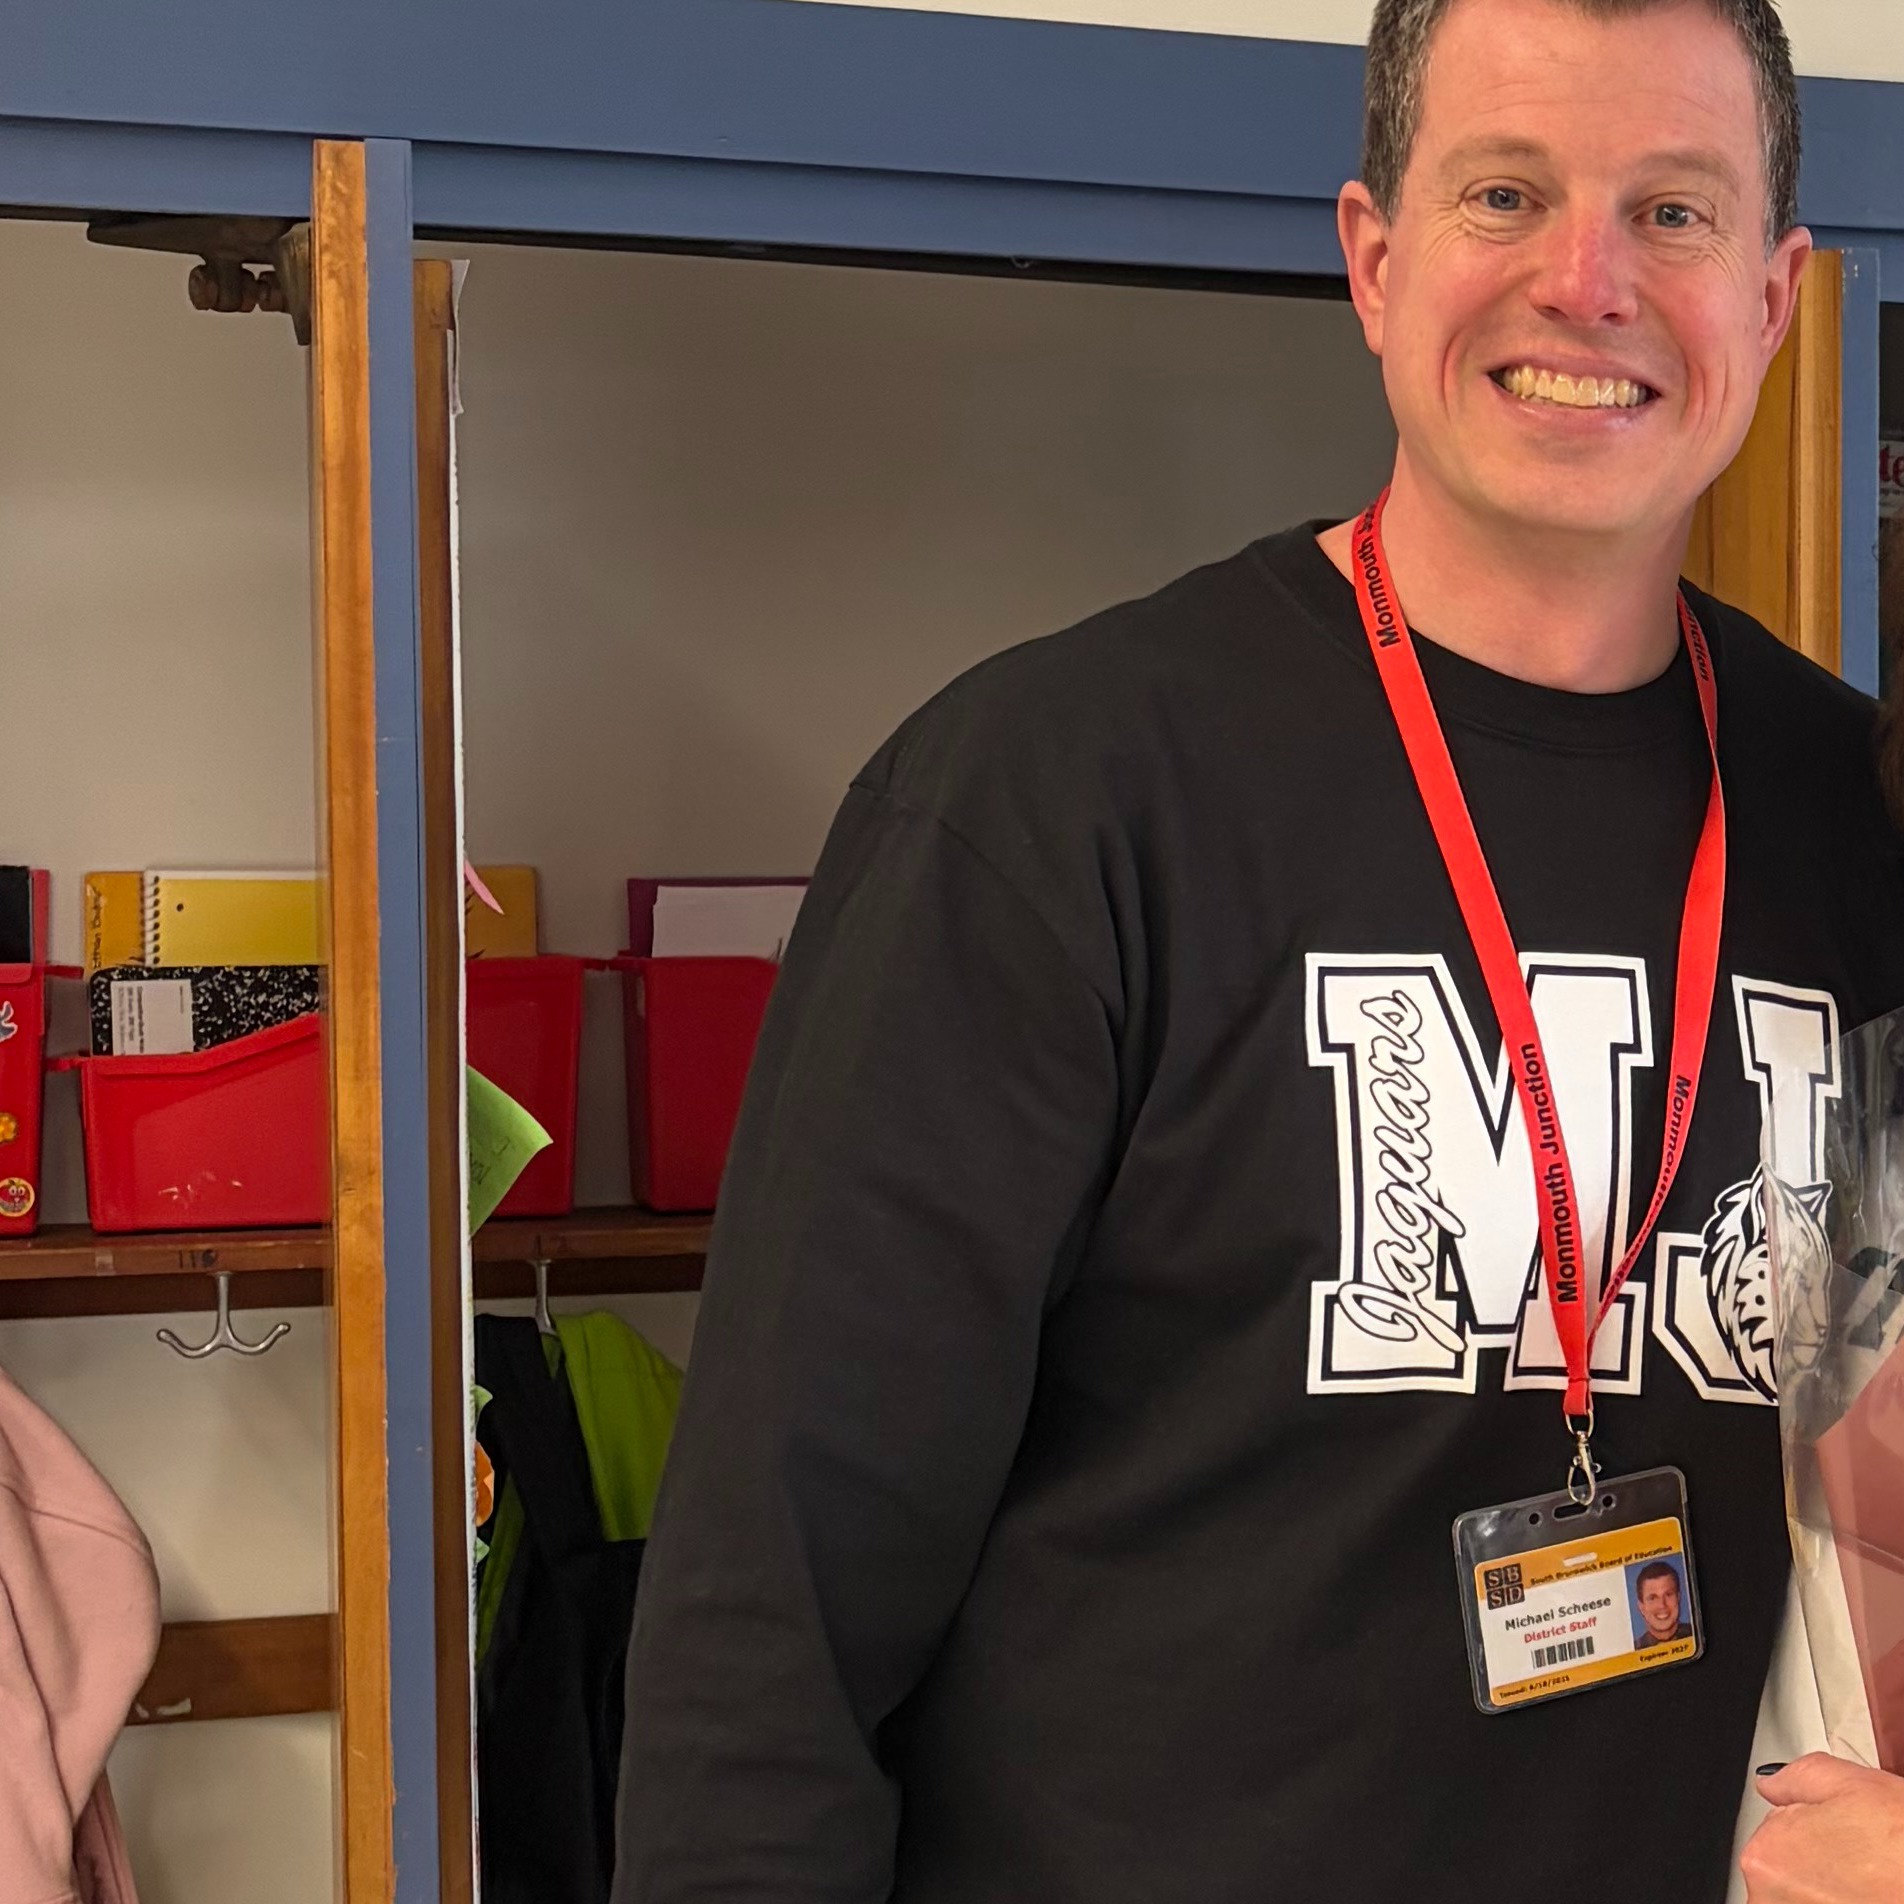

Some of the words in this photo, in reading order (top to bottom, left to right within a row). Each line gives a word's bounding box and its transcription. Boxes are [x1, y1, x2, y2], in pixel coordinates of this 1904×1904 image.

[1358, 534, 1402, 648] Monmouth
[1517, 1043, 1561, 1156] Junction
[1337, 989, 1466, 1354] Jaguars
[1544, 1163, 1581, 1304] Monmouth
[1504, 1609, 1555, 1631] Michael
[1558, 1596, 1612, 1618] Scheese
[1524, 1624, 1566, 1643] District
[1569, 1617, 1597, 1633] Staff
